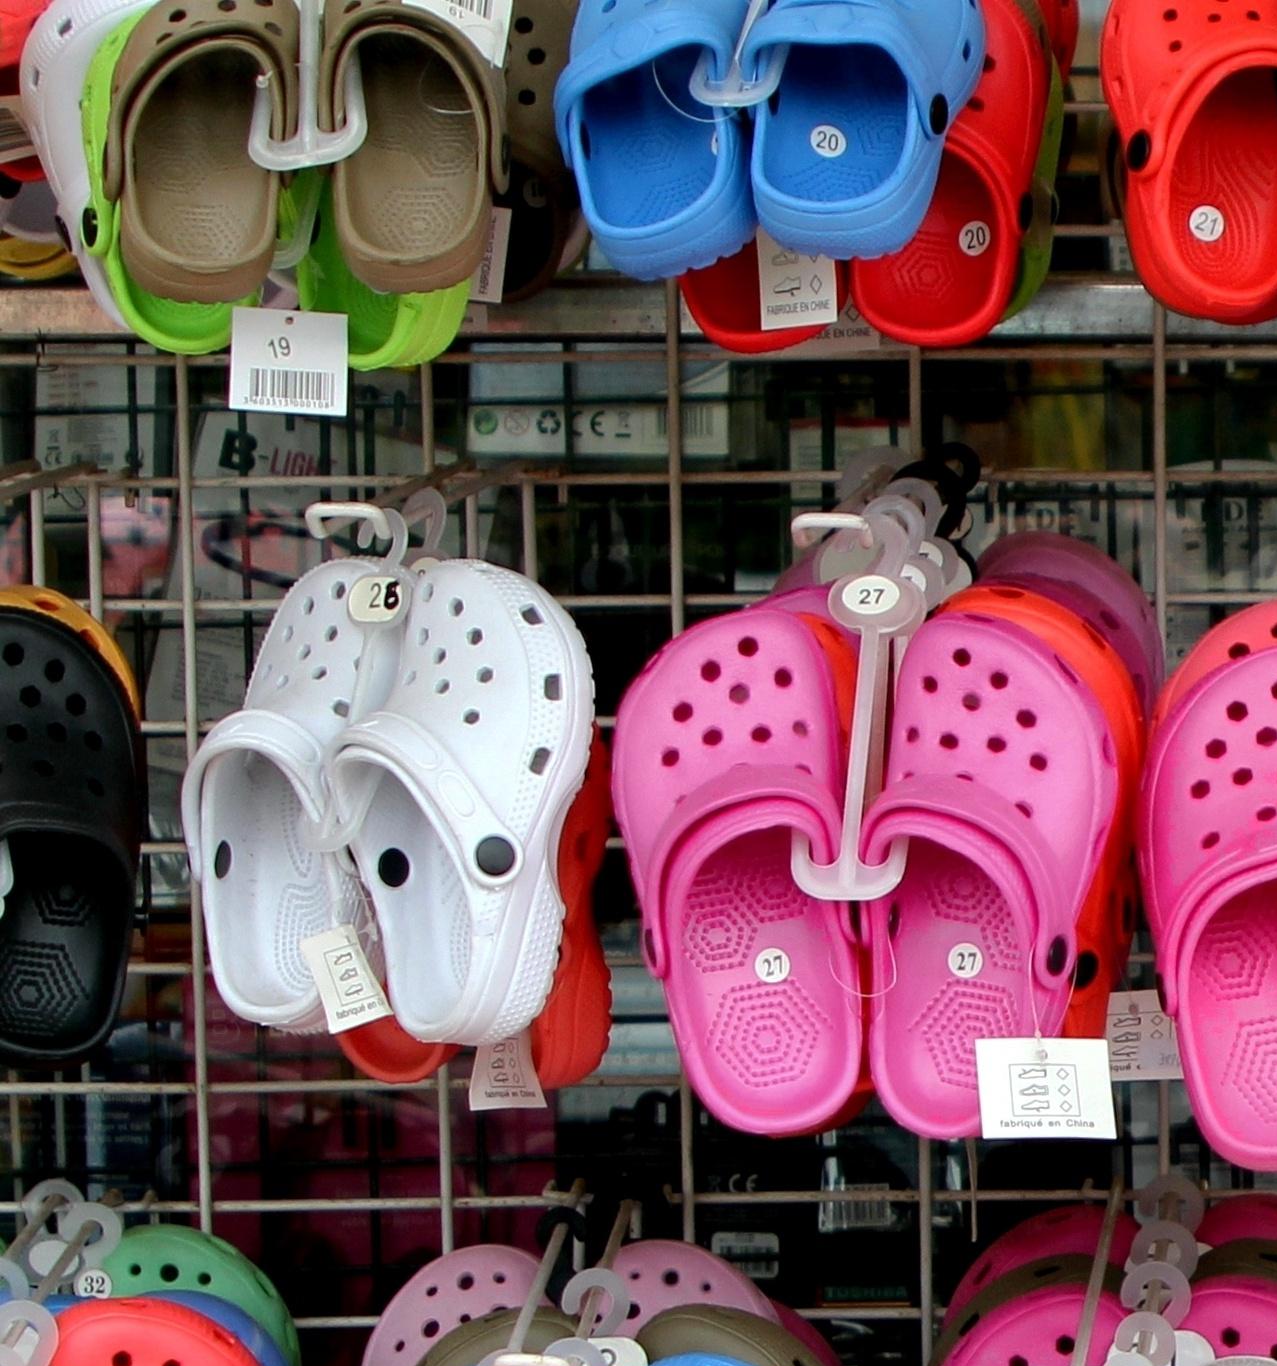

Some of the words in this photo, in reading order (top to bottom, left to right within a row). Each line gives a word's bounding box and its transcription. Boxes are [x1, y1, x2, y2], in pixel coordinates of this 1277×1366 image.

[816, 131, 839, 152] 20
[1195, 211, 1218, 236] 21
[964, 227, 985, 250] 20
[267, 336, 292, 358] 19
[859, 588, 888, 605] 27
[762, 955, 784, 977] 27
[958, 952, 978, 971] 27
[1000, 1119, 1043, 1131] fabriqué
[1066, 1118, 1095, 1128] China
[84, 1276, 106, 1294] 32
